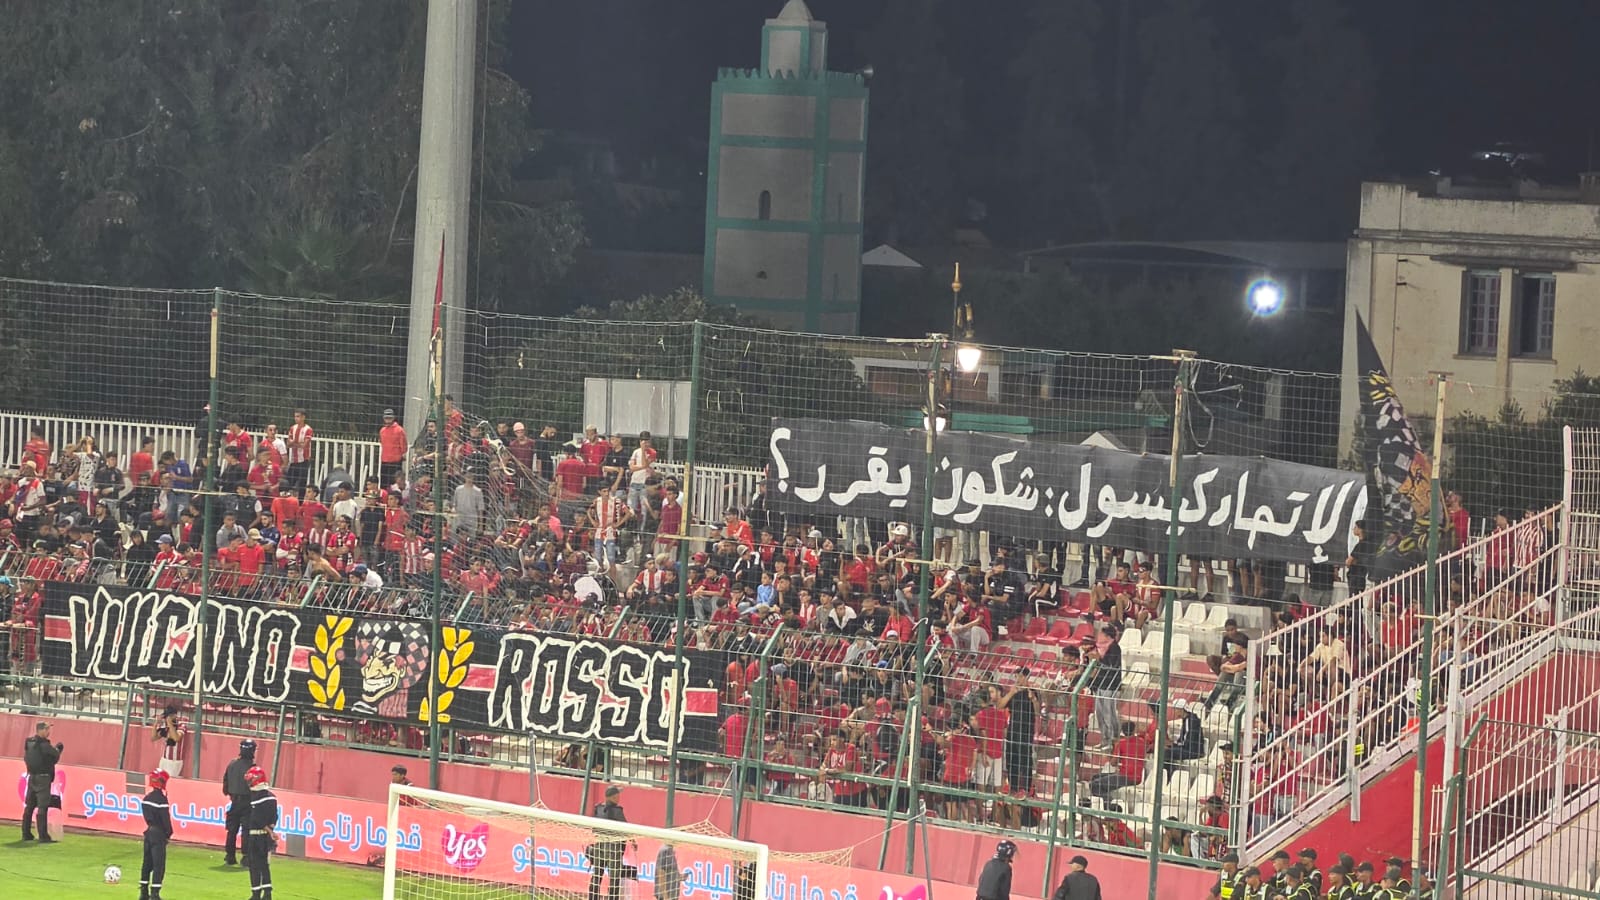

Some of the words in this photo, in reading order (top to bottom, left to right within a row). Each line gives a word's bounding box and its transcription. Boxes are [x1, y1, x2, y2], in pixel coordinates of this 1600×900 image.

[927, 449, 1039, 525] شكون
[68, 585, 302, 704] VULCANO
[486, 632, 691, 747] ROSSO
[83, 784, 143, 821] حيحتو
[682, 860, 734, 900] ليلتو
